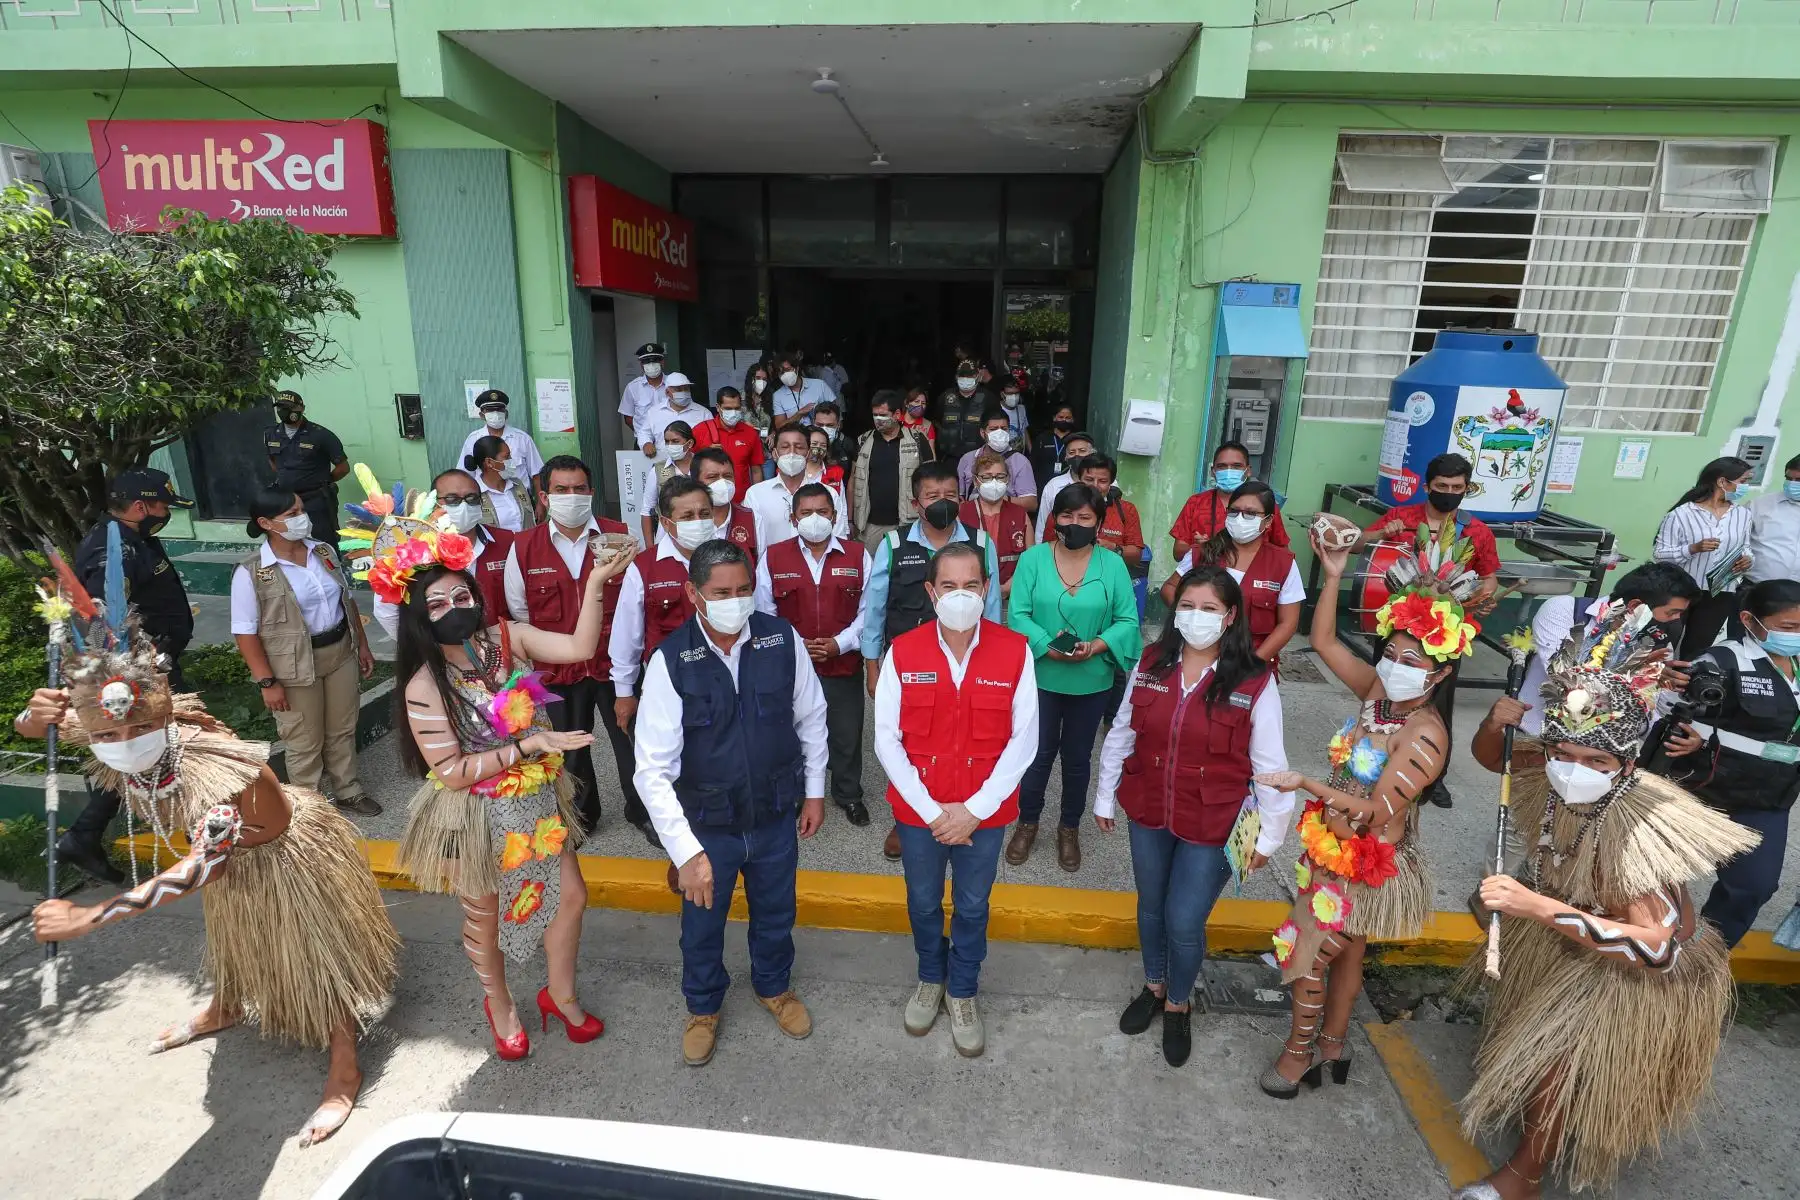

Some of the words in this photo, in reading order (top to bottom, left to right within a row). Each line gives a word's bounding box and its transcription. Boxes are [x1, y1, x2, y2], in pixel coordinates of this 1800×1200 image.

[121, 133, 344, 191] multiRed
[253, 204, 283, 217] Banco
[285, 204, 299, 217] de
[300, 204, 310, 217] la
[313, 203, 348, 217] Nación
[612, 217, 688, 268] multiRed
[1393, 483, 1412, 497] VIDA
[1741, 675, 1772, 684] MUNICIPALIDAD
